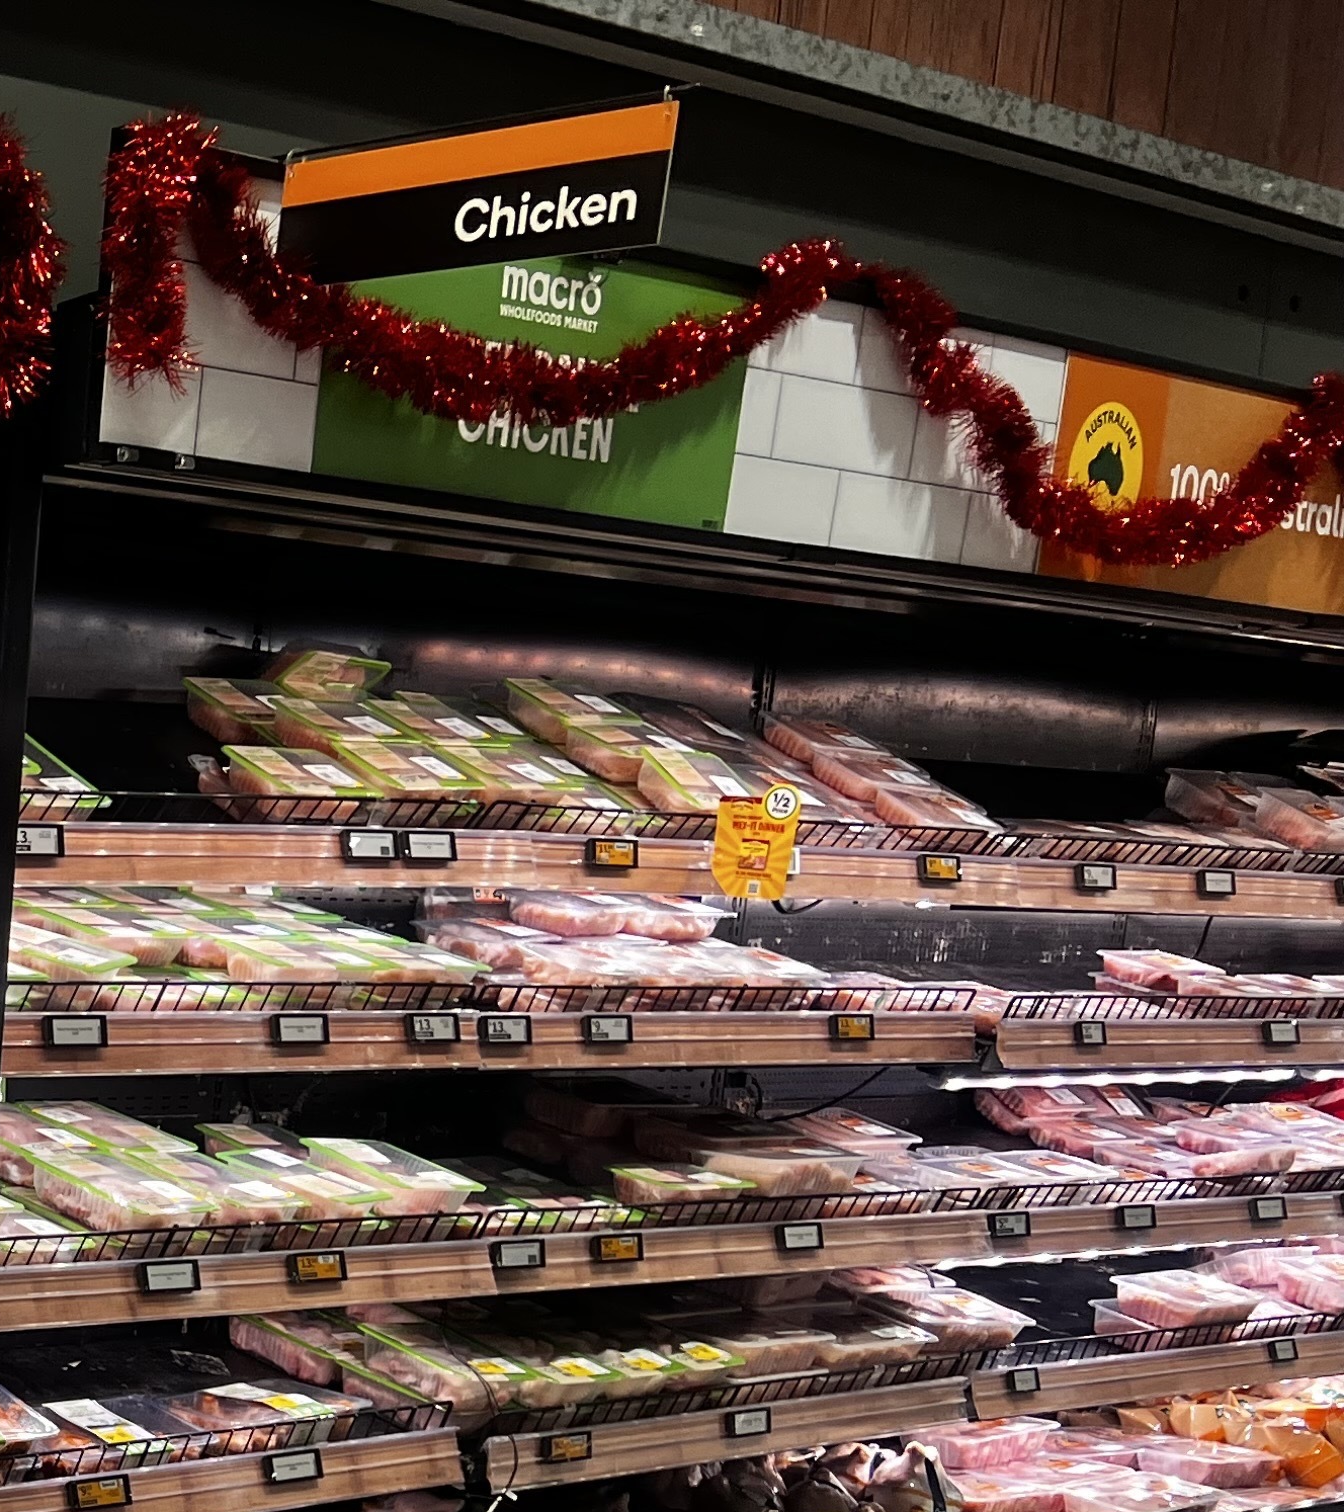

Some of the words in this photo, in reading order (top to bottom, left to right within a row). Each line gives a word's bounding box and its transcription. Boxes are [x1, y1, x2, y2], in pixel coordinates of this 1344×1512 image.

[454, 186, 637, 242] Chicken
[500, 304, 562, 327] WHOLEFOODS
[564, 315, 598, 333] MARKET
[1084, 409, 1138, 451] AUSTRALIAN
[773, 792, 790, 809] 1/2
